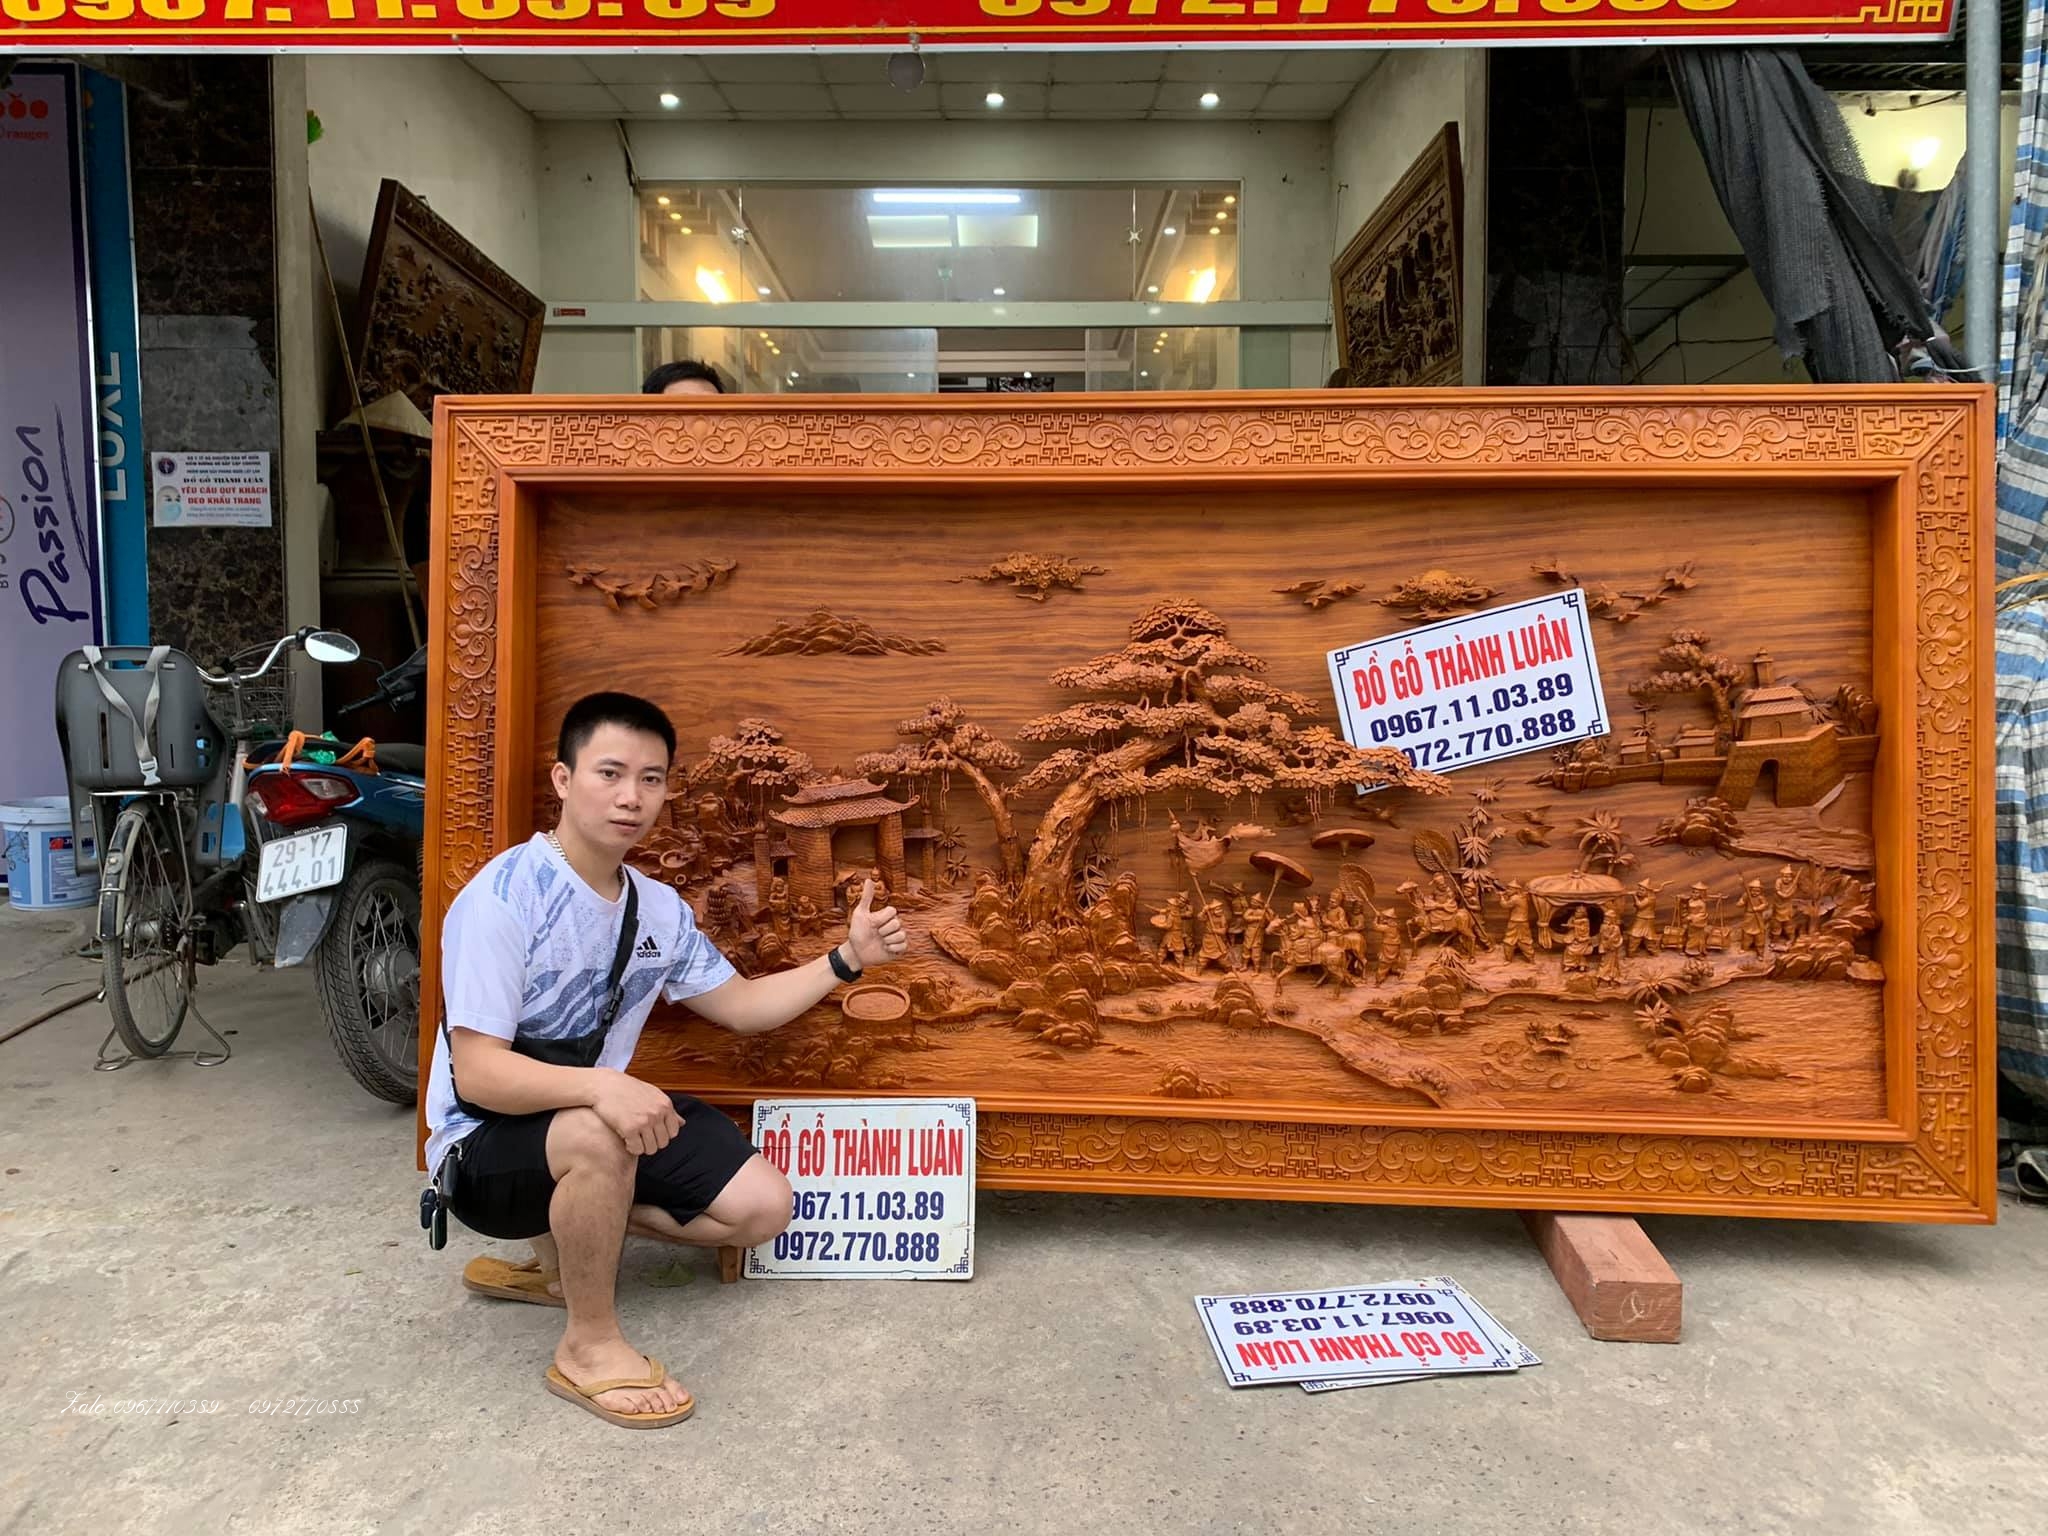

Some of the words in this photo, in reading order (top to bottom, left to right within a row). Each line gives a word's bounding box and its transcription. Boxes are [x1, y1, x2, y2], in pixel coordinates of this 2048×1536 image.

[15, 424, 90, 626] Passion
[1352, 650, 1387, 710] ĐỒ
[1389, 640, 1424, 701] GỖ
[1425, 634, 1507, 691] THÀNH
[1507, 613, 1574, 671] LUÂN
[1370, 672, 1574, 743] 0967.11.03.89
[1401, 708, 1576, 769] 72.770.888
[272, 832, 332, 868] 29-Y7
[263, 856, 336, 896] 444.01
[798, 1112, 826, 1177] GỖ
[832, 1119, 901, 1177] THÀNH
[907, 1119, 963, 1177] LUÂN
[791, 1191, 944, 1221] 967.11.03.89
[774, 1231, 940, 1262] 0972.770.888
[1230, 1292, 1436, 1315] 0972.770.888
[1235, 1311, 1455, 1336] 0967.11.03.89
[1235, 1338, 1311, 1371] LUÂN
[1309, 1332, 1403, 1365] THÀNH
[1399, 1330, 1443, 1367] GỖ
[1441, 1330, 1486, 1364] ĐỒ
